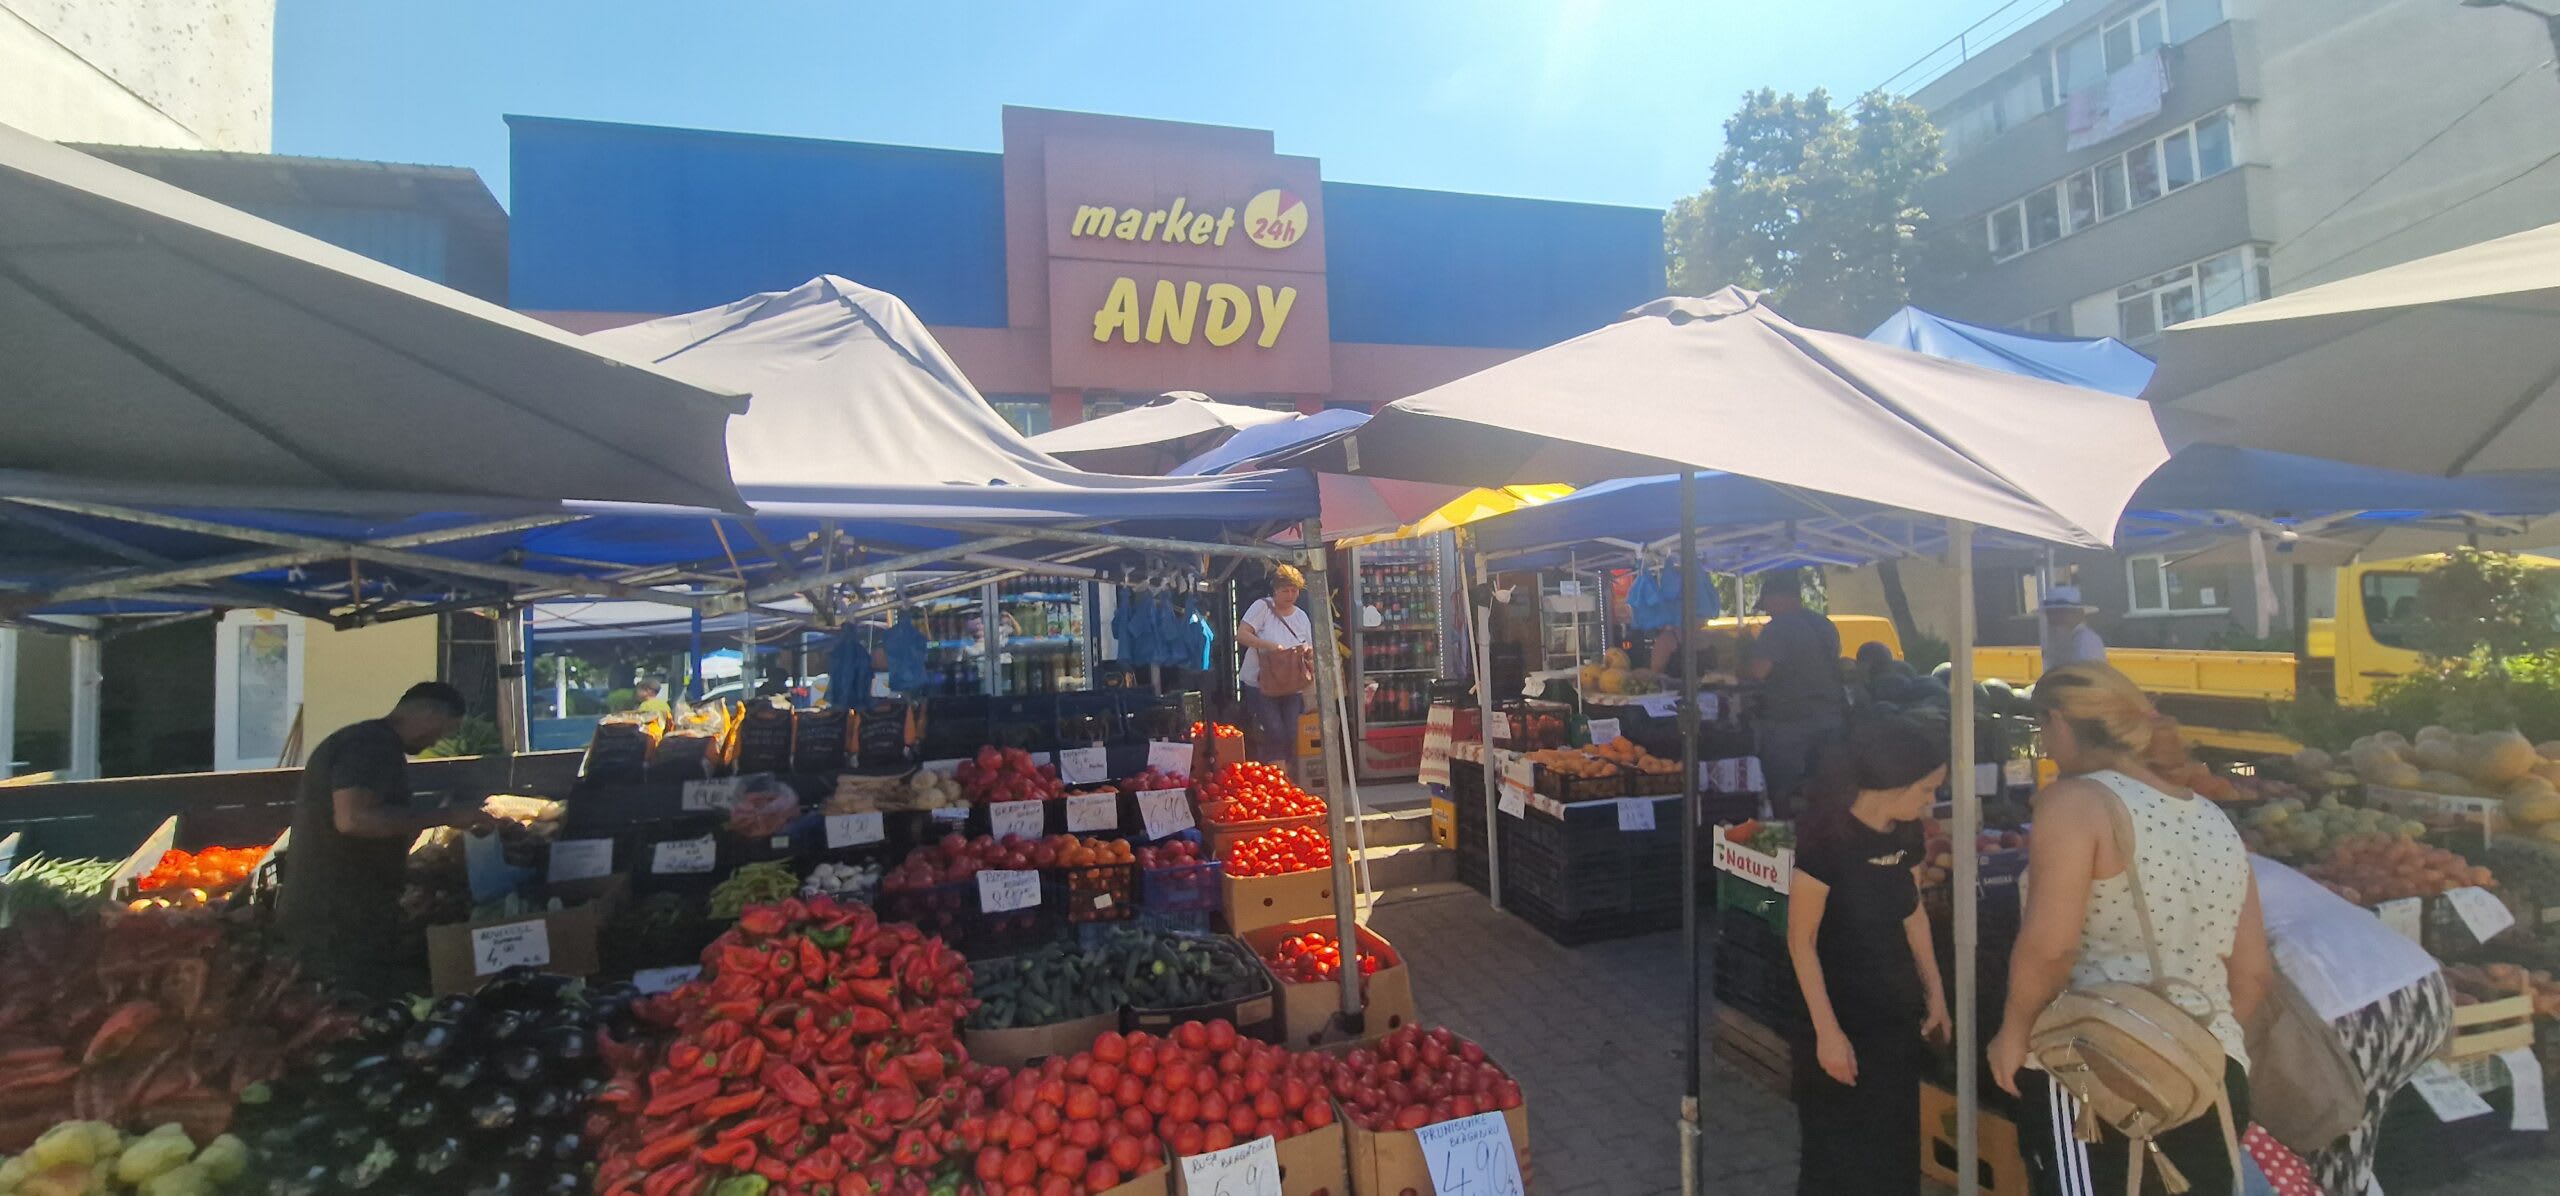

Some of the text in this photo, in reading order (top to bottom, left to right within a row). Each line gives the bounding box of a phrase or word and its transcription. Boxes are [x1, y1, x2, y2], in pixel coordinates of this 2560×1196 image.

[1071, 197, 1235, 247] market
[1252, 217, 1296, 243] 24h
[1093, 276, 1297, 349] ANDY
